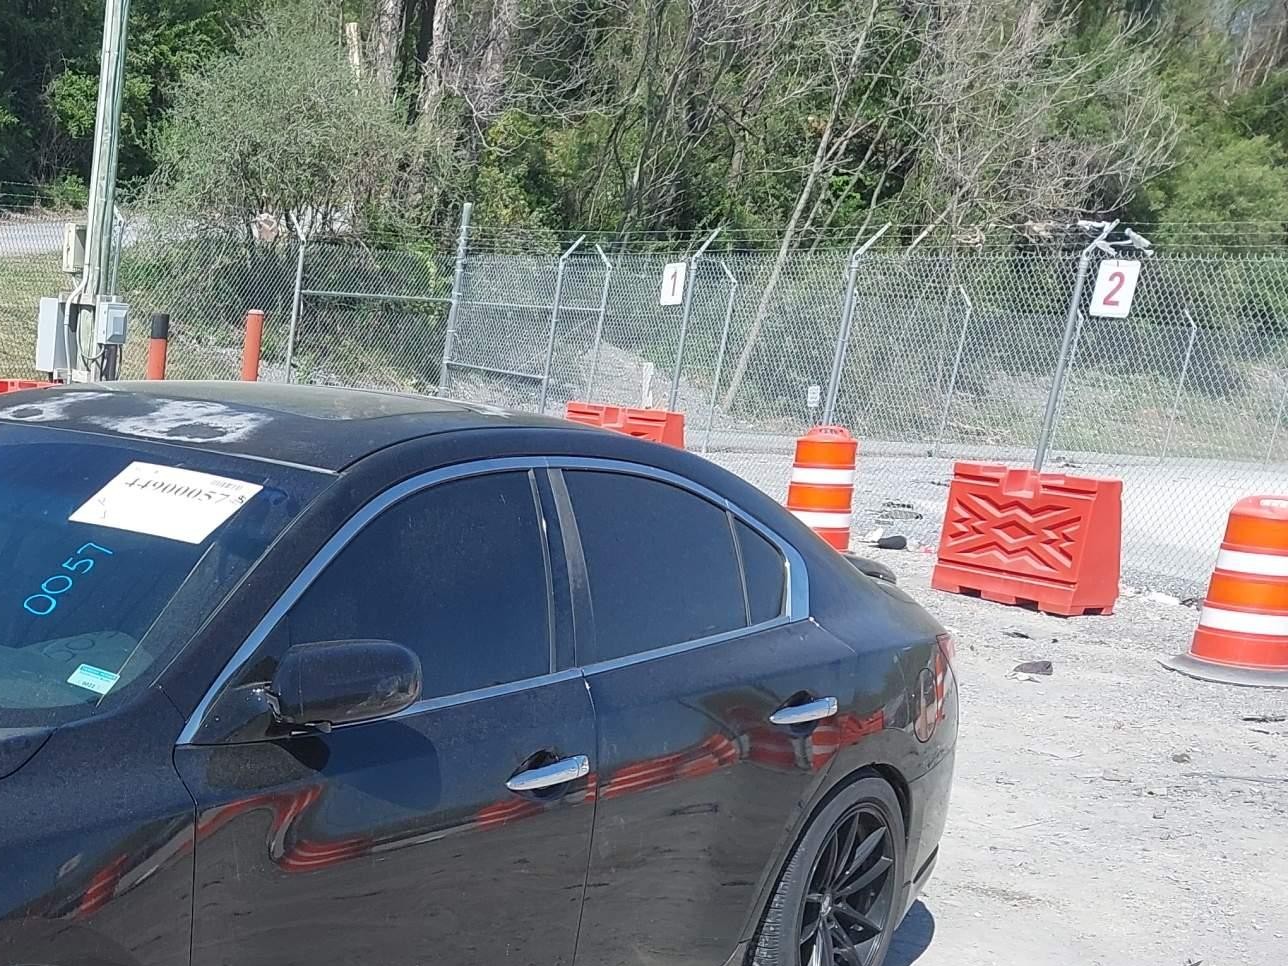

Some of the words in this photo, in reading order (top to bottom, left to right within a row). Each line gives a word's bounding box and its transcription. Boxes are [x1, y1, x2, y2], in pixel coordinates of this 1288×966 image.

[670, 271, 678, 297] 1
[1102, 271, 1126, 306] 2
[23, 542, 113, 615] 0057
